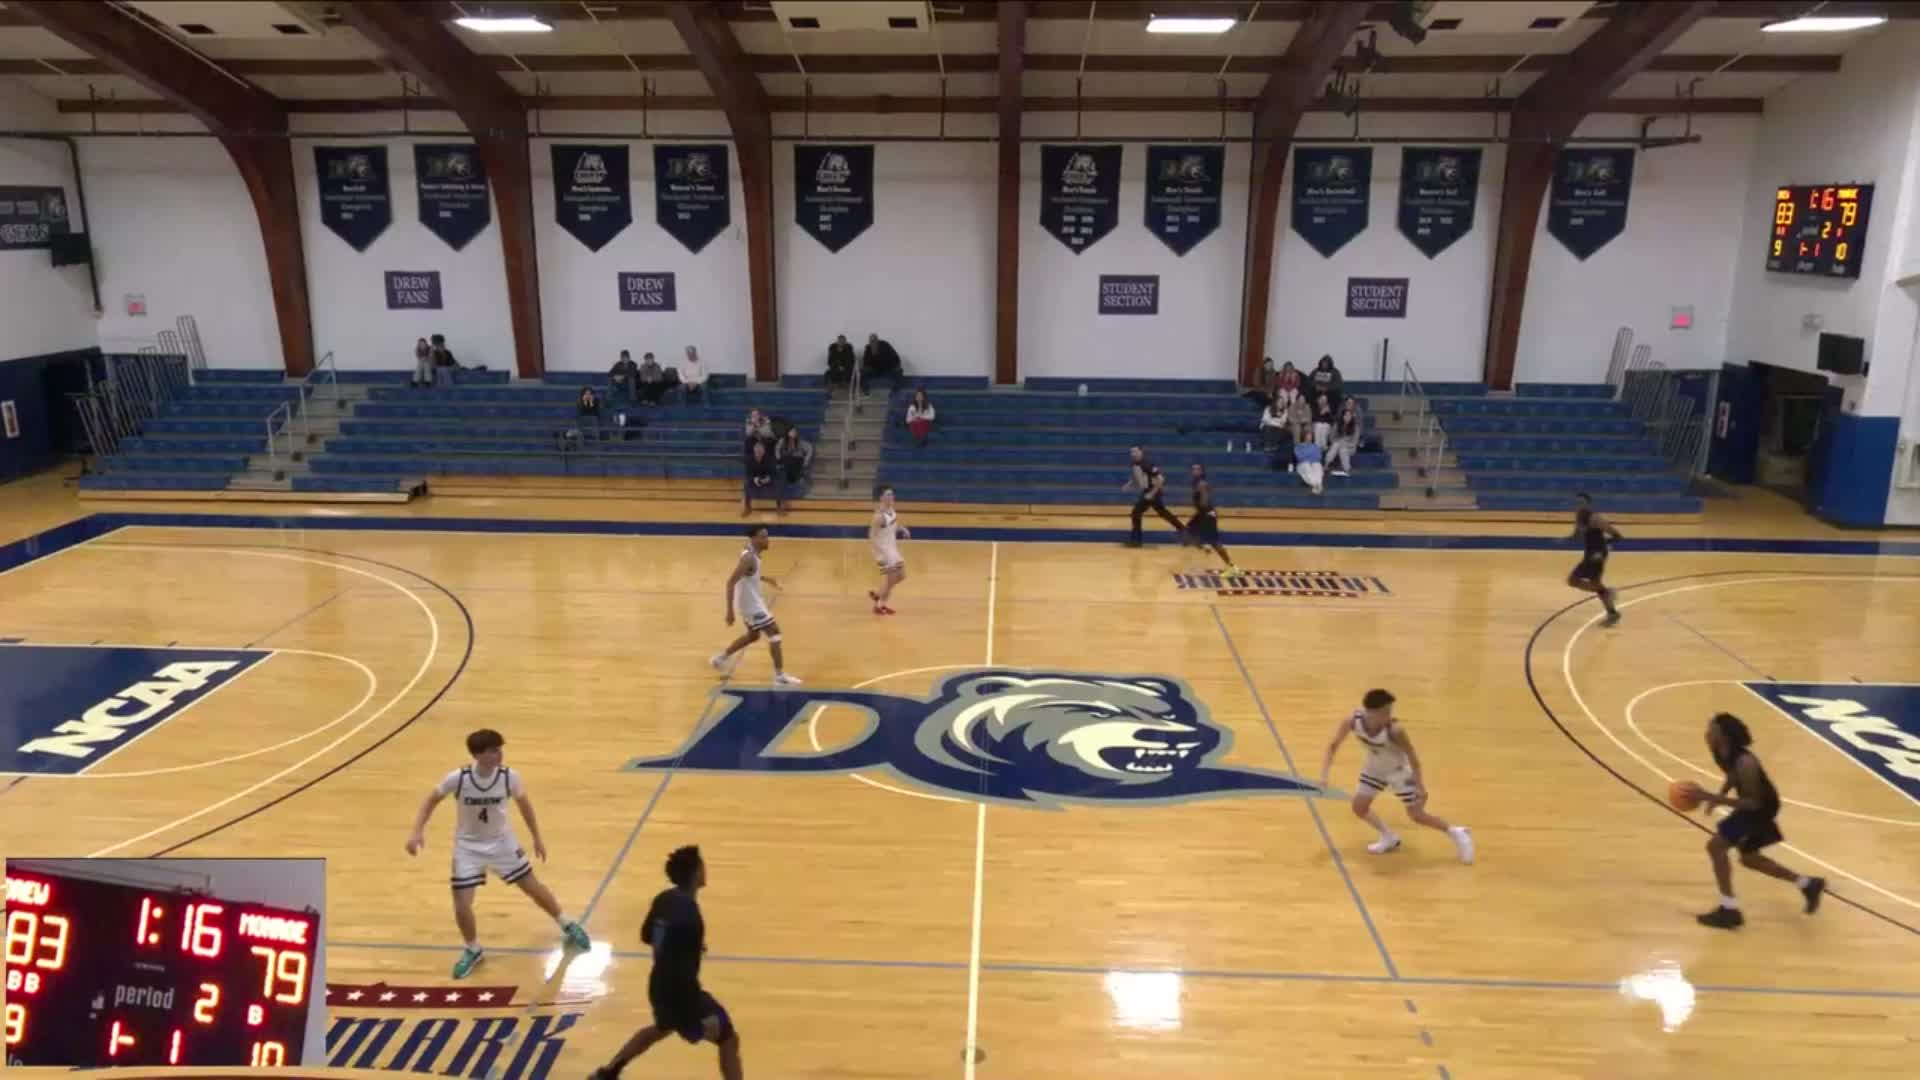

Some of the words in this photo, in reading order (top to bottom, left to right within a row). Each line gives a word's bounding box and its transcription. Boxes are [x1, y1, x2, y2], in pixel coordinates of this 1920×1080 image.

[392, 275, 431, 290] DREW
[626, 276, 665, 291] DREW
[1103, 281, 1154, 294] STUDENT
[396, 290, 430, 304] FANS
[630, 291, 664, 305] FANS
[1351, 285, 1404, 298] STUDENT
[1103, 295, 1153, 307] SECTION
[1351, 298, 1401, 311] SECTION
[17, 660, 242, 759] NCAA
[478, 807, 489, 824] 4
